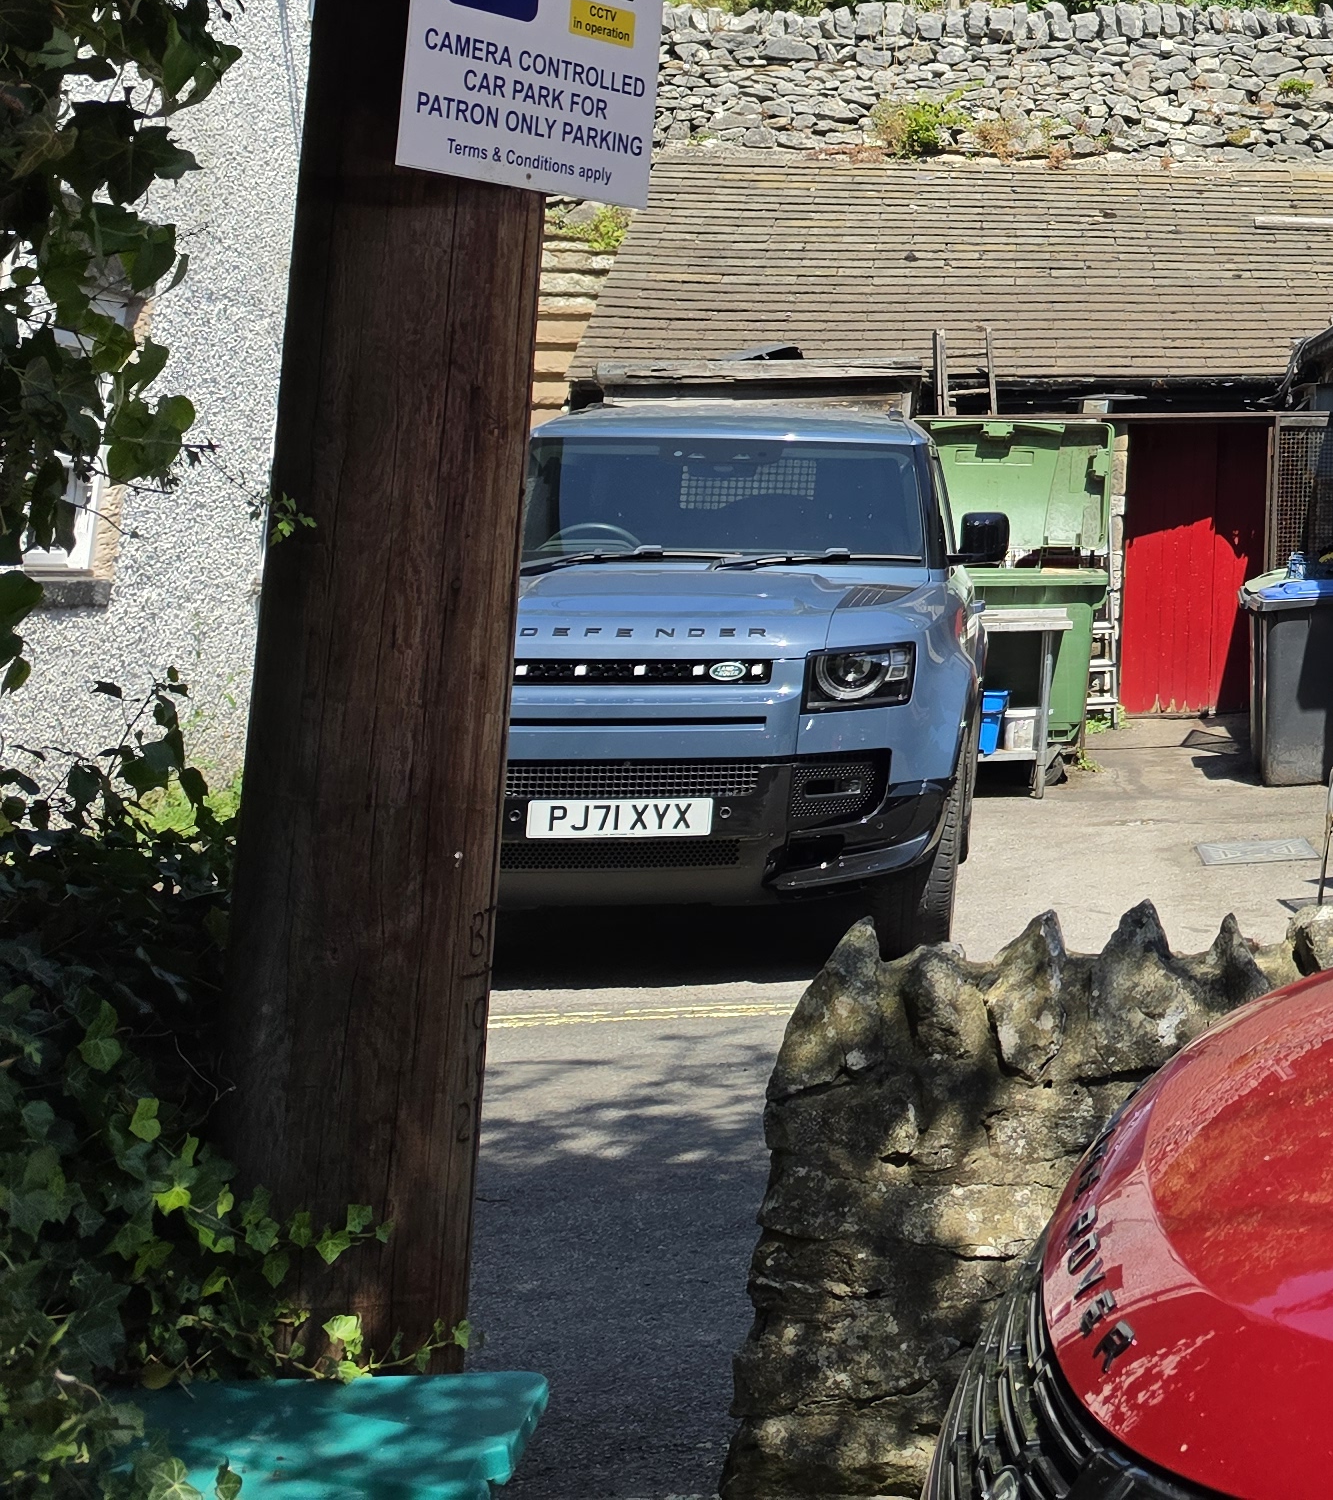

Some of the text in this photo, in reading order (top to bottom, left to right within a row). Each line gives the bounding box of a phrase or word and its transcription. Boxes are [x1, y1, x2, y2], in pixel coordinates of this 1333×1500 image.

[573, 16, 630, 42] in operation
[589, 5, 617, 22] CCTV
[424, 27, 646, 98] CAMERA CONTROLLED
[463, 69, 608, 120] CAR PARK FOR
[416, 91, 643, 157] PATRON ONLY PARKING
[447, 137, 612, 186] Terms & Conditions apply
[519, 627, 767, 638] DEFENDER
[548, 803, 692, 832] PJ71 XYX
[1067, 1205, 1135, 1373] ROVER
